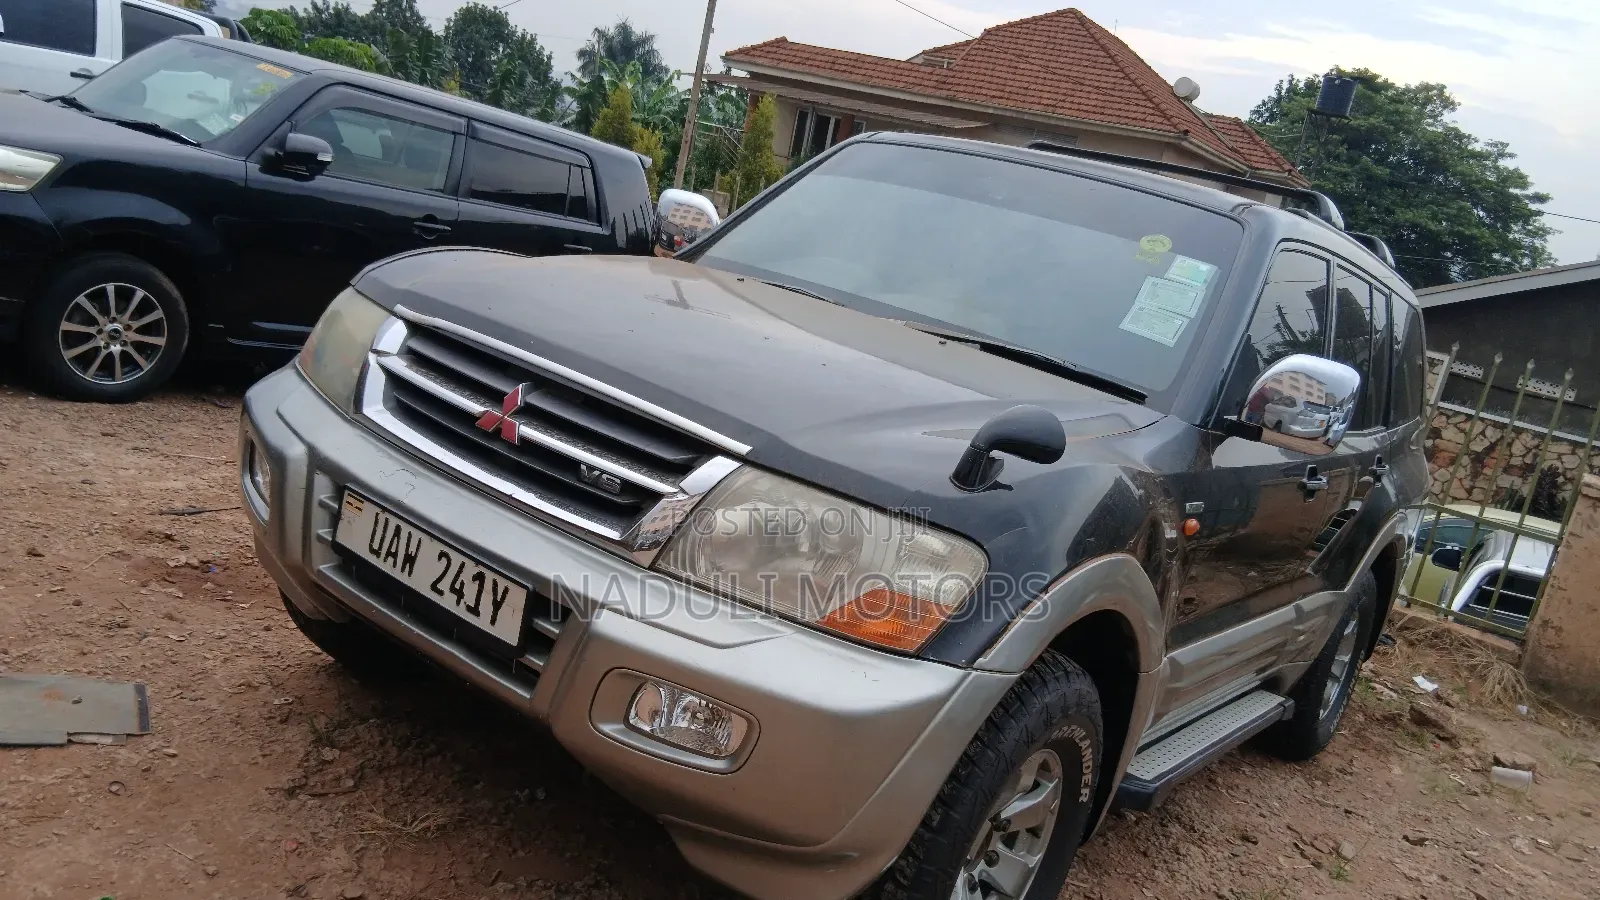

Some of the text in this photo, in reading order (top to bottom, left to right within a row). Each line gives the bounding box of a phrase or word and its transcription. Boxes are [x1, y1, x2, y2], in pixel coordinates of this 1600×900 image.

[581, 464, 621, 494] V6
[368, 511, 509, 626] UAW 241Y
